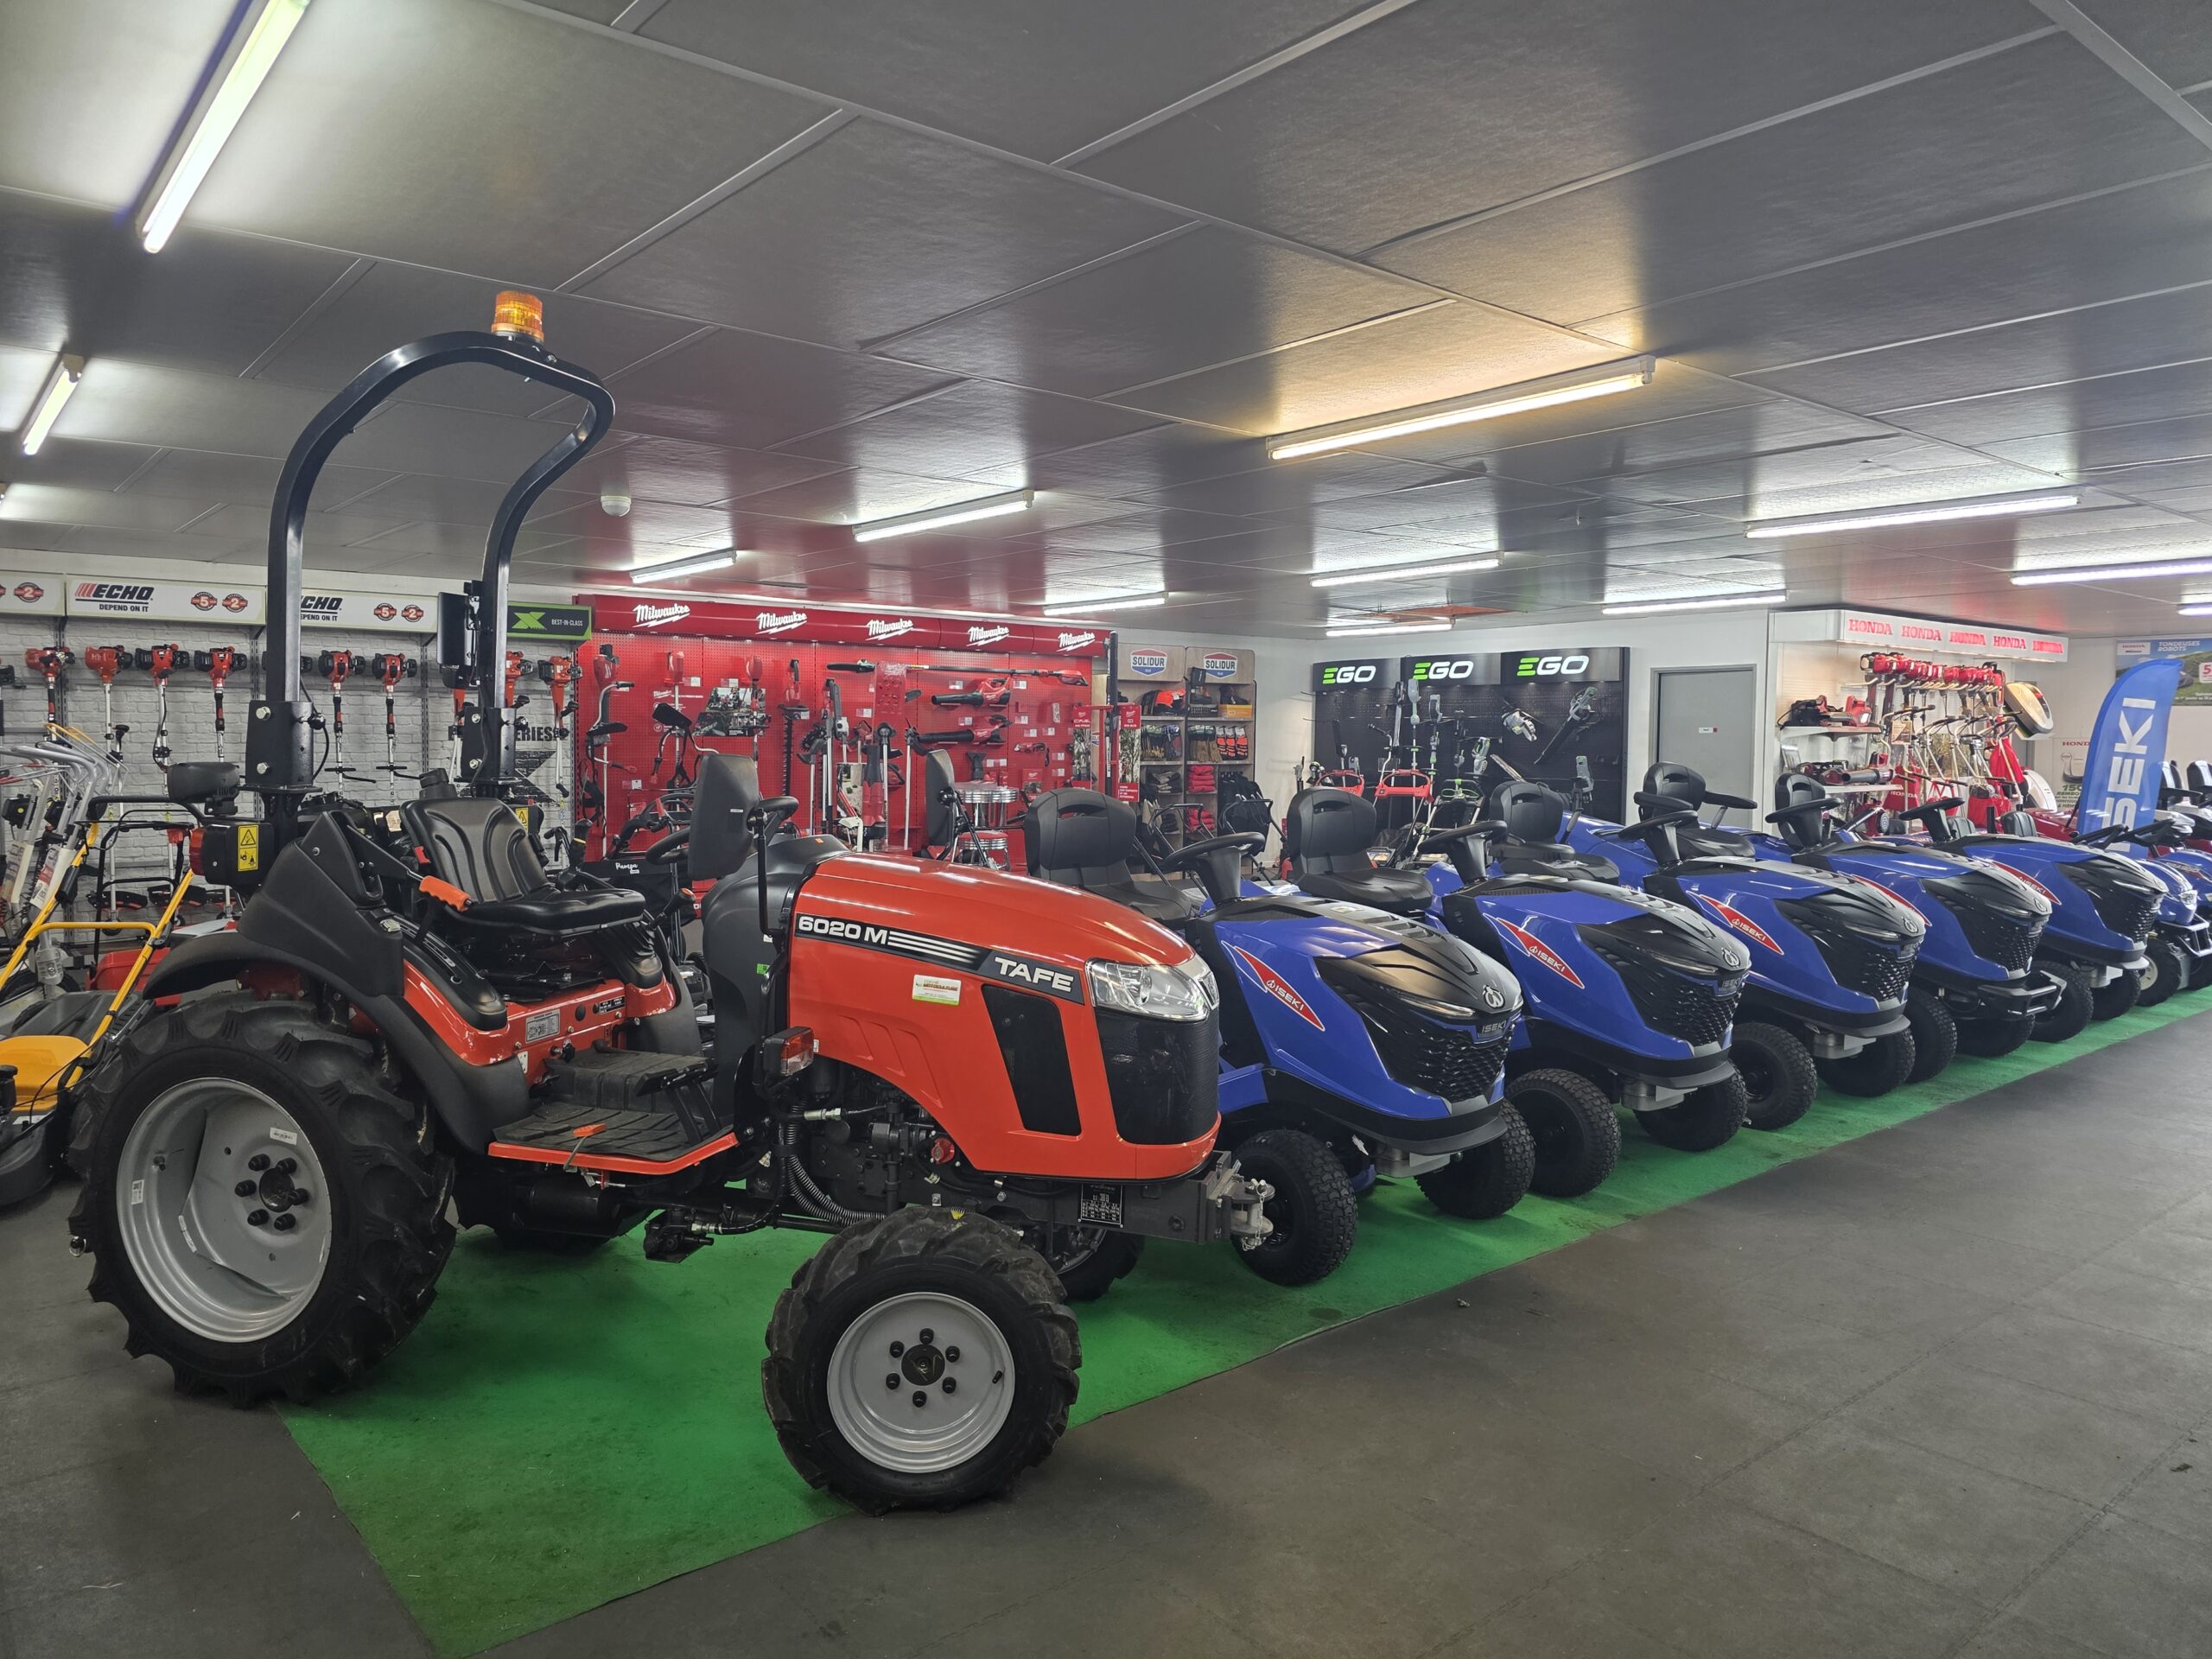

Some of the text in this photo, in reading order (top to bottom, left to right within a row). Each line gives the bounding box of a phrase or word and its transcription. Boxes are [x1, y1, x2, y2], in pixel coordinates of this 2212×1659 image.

[92, 585, 154, 601] ECHO
[99, 603, 129, 612] DEPEND
[301, 595, 343, 611] CHO
[632, 603, 690, 624] Milwaukee
[756, 611, 808, 630] Milwaukee
[867, 618, 913, 637] Milwaukee
[968, 625, 1009, 643] Milwaukee
[1848, 619, 1893, 636] HONDA
[1901, 625, 1942, 641] HONDA
[1058, 632, 1096, 649] Milwaukee
[1949, 631, 1986, 646] HONDA
[1993, 635, 2027, 650] HONDA
[2032, 639, 2064, 654] HONDA
[1132, 657, 1165, 667] SOLIDUR
[1205, 660, 1236, 671] SOLIDUR
[1412, 660, 1474, 681] EGO
[1516, 654, 1590, 677] EGO
[1322, 665, 1376, 684] EGO
[515, 726, 555, 741] ERIES
[798, 915, 888, 945] 6020 M
[1739, 921, 1766, 942] ISEKI
[1537, 950, 1566, 972] ISEKI
[994, 956, 1074, 993] TAFE
[1274, 985, 1305, 1011] ISEKI
[1481, 1020, 1507, 1033] ISEKI
